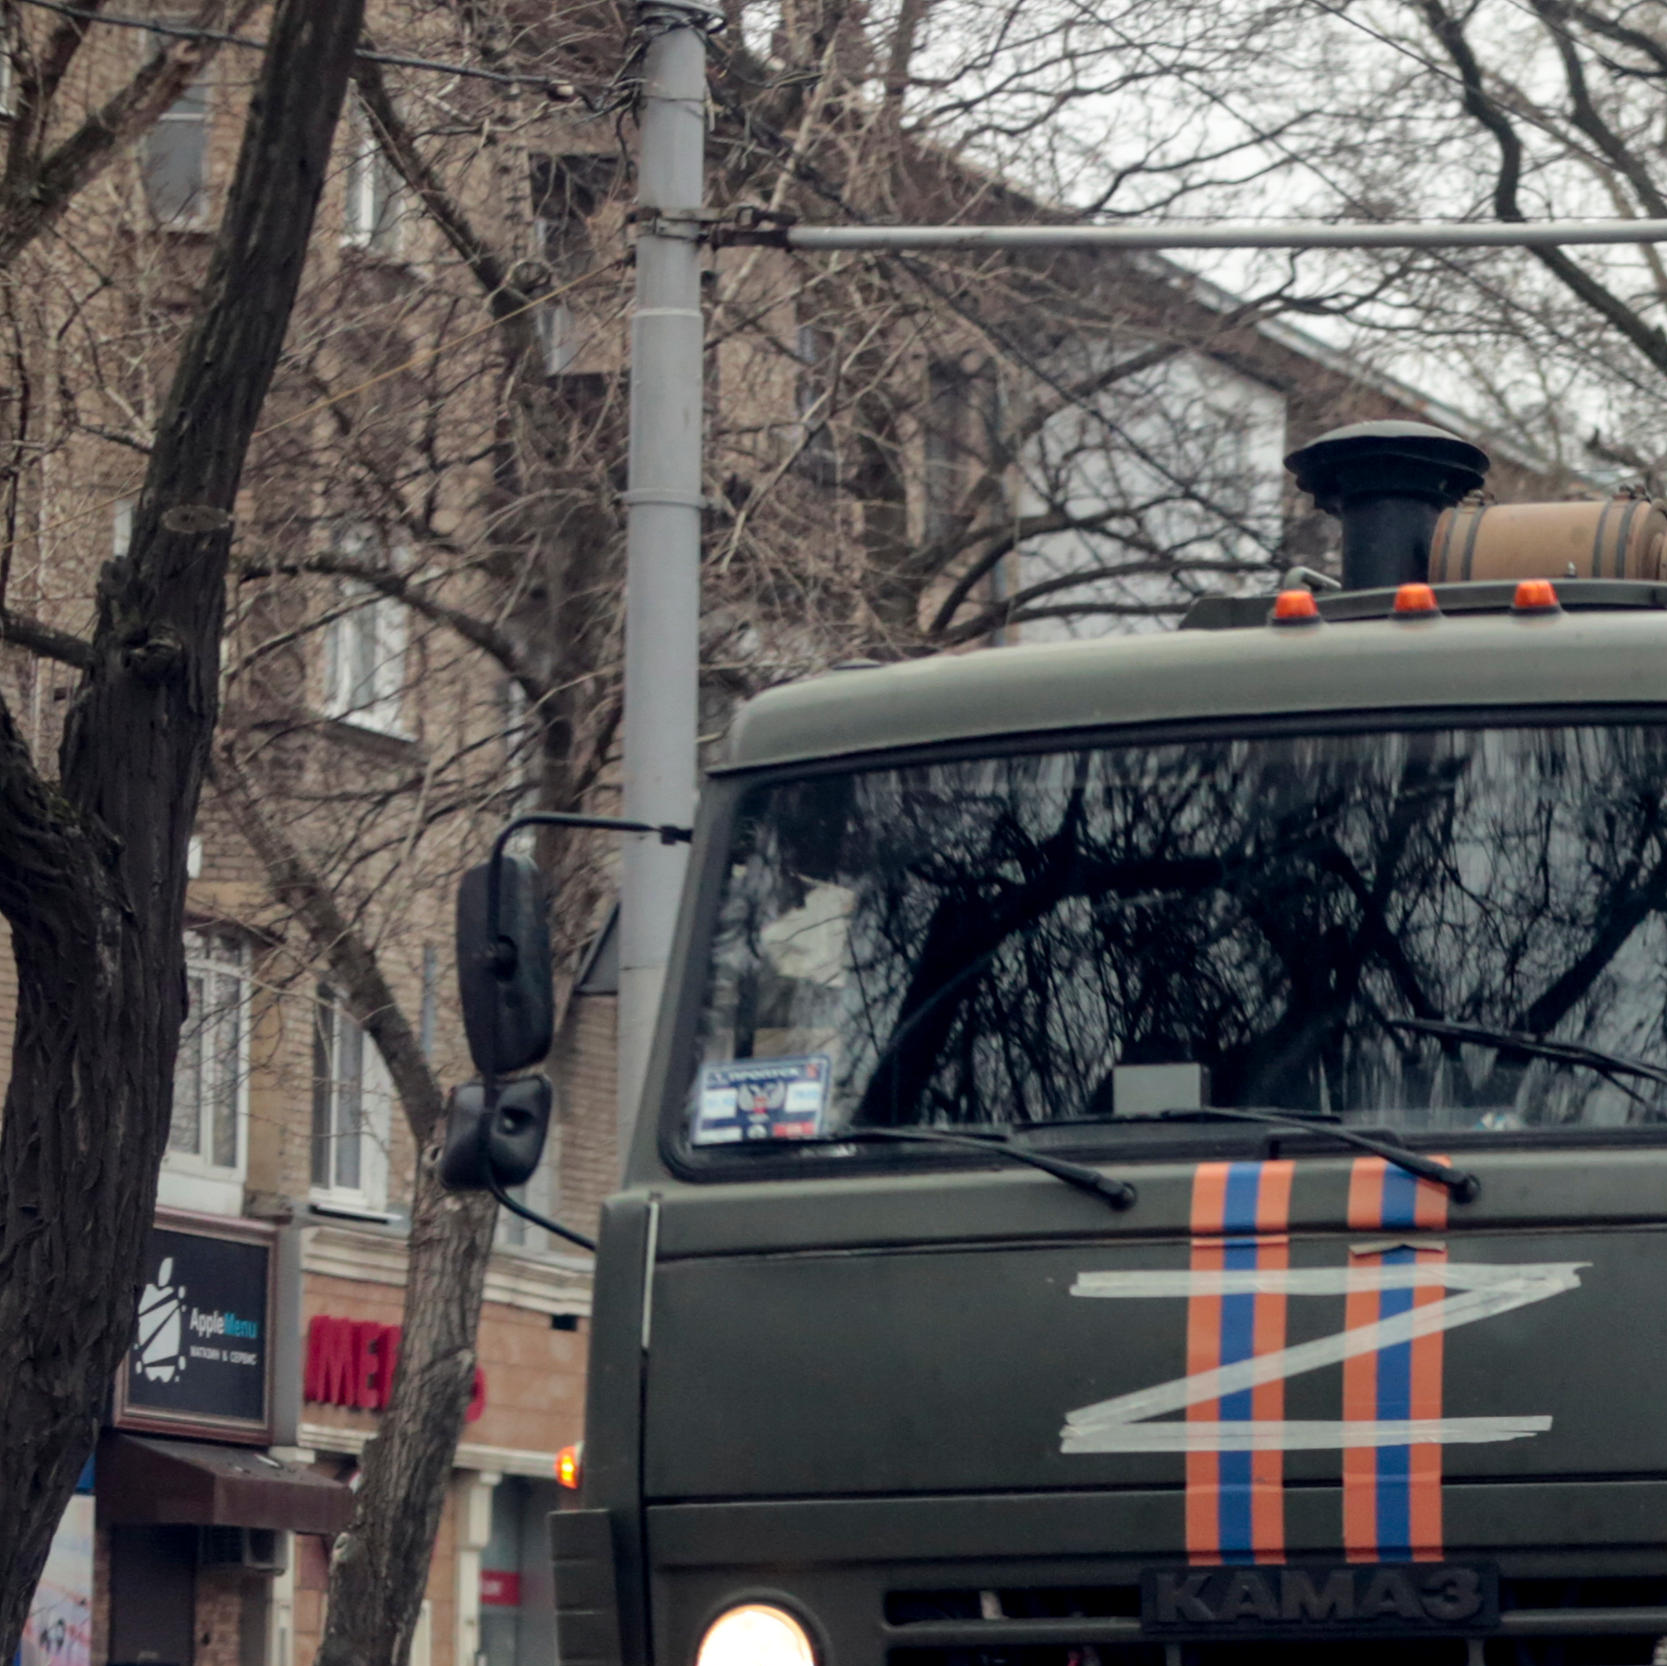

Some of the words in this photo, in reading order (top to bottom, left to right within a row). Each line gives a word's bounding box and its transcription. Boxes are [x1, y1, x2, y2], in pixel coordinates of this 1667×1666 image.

[189, 1307, 257, 1339] AppleMenu
[1060, 1261, 1594, 1454] Z
[1155, 1567, 1483, 1623] КАМАЗ
